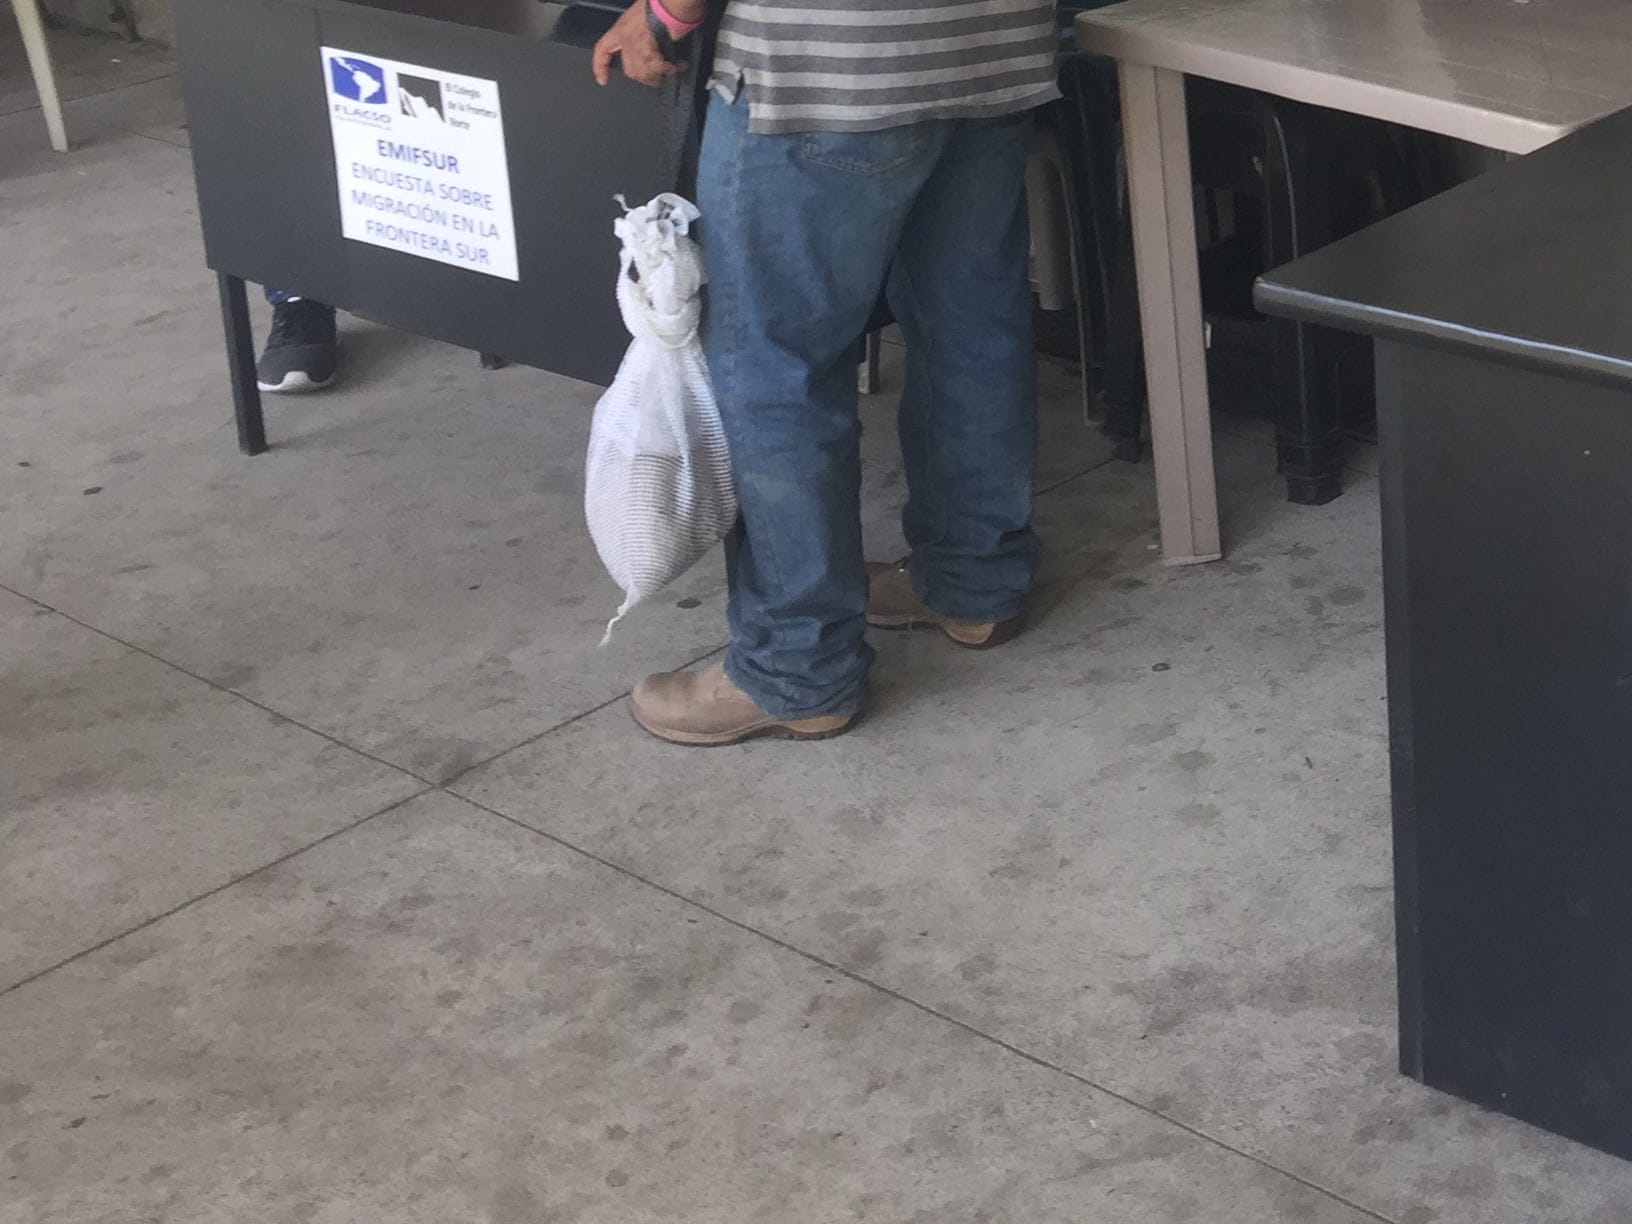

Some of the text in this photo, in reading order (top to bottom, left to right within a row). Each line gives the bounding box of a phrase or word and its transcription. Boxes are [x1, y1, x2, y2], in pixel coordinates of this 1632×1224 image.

[334, 104, 392, 124] FLACSO
[377, 139, 460, 174] EMIFSUR
[351, 162, 494, 211] ENCUESTA SOBRE
[351, 189, 500, 240] MIGRACIÓN EN LA
[366, 219, 491, 265] FRONTERA SUR
